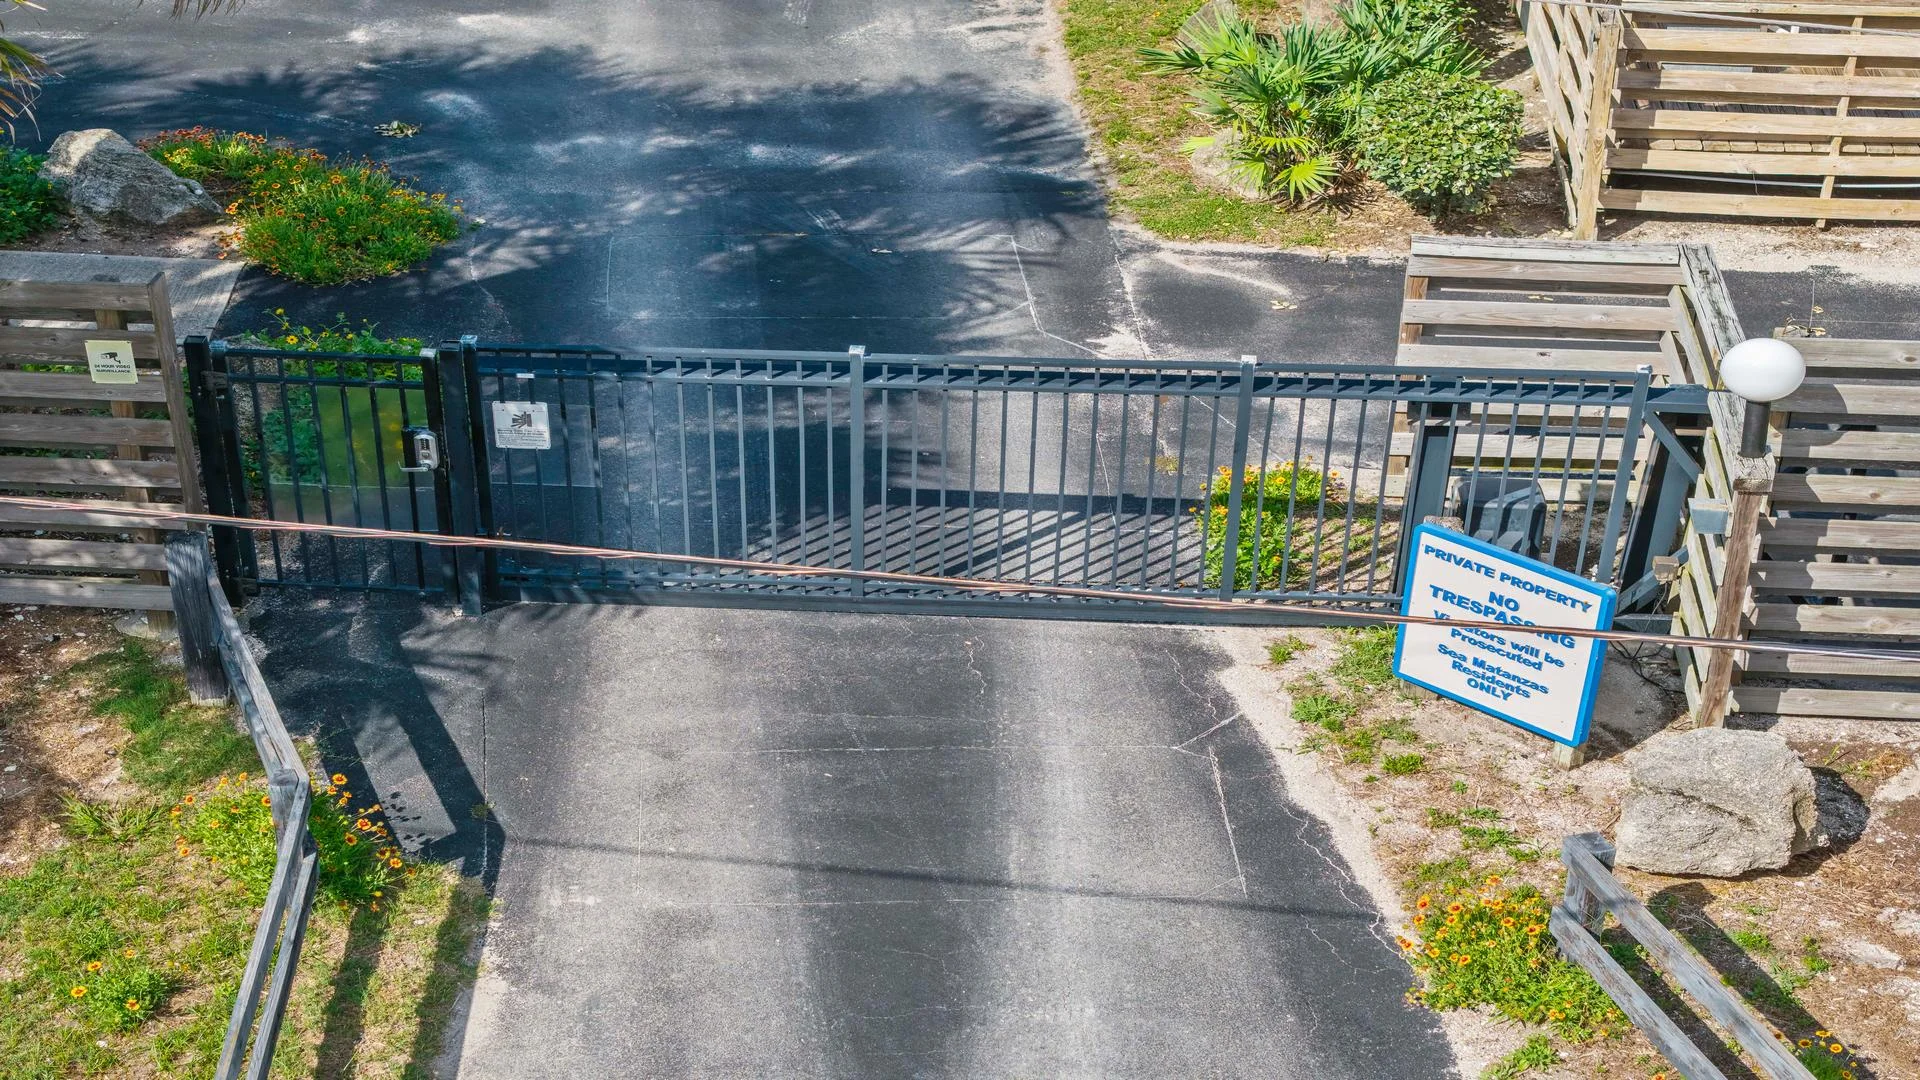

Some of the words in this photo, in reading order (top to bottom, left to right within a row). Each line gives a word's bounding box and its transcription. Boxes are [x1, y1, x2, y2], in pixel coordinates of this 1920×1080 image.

[1424, 544, 1496, 578] PRIVATE
[1500, 572, 1592, 612] PROPERTY
[1488, 591, 1520, 612] NO
[1450, 628, 1543, 671] Prosecuted
[1511, 640, 1540, 658] will
[1544, 652, 1564, 667] be
[1438, 644, 1467, 663] Sea
[1472, 657, 1549, 694] Matanzas
[1451, 660, 1531, 698] Residents
[1467, 678, 1512, 701] ONLY
